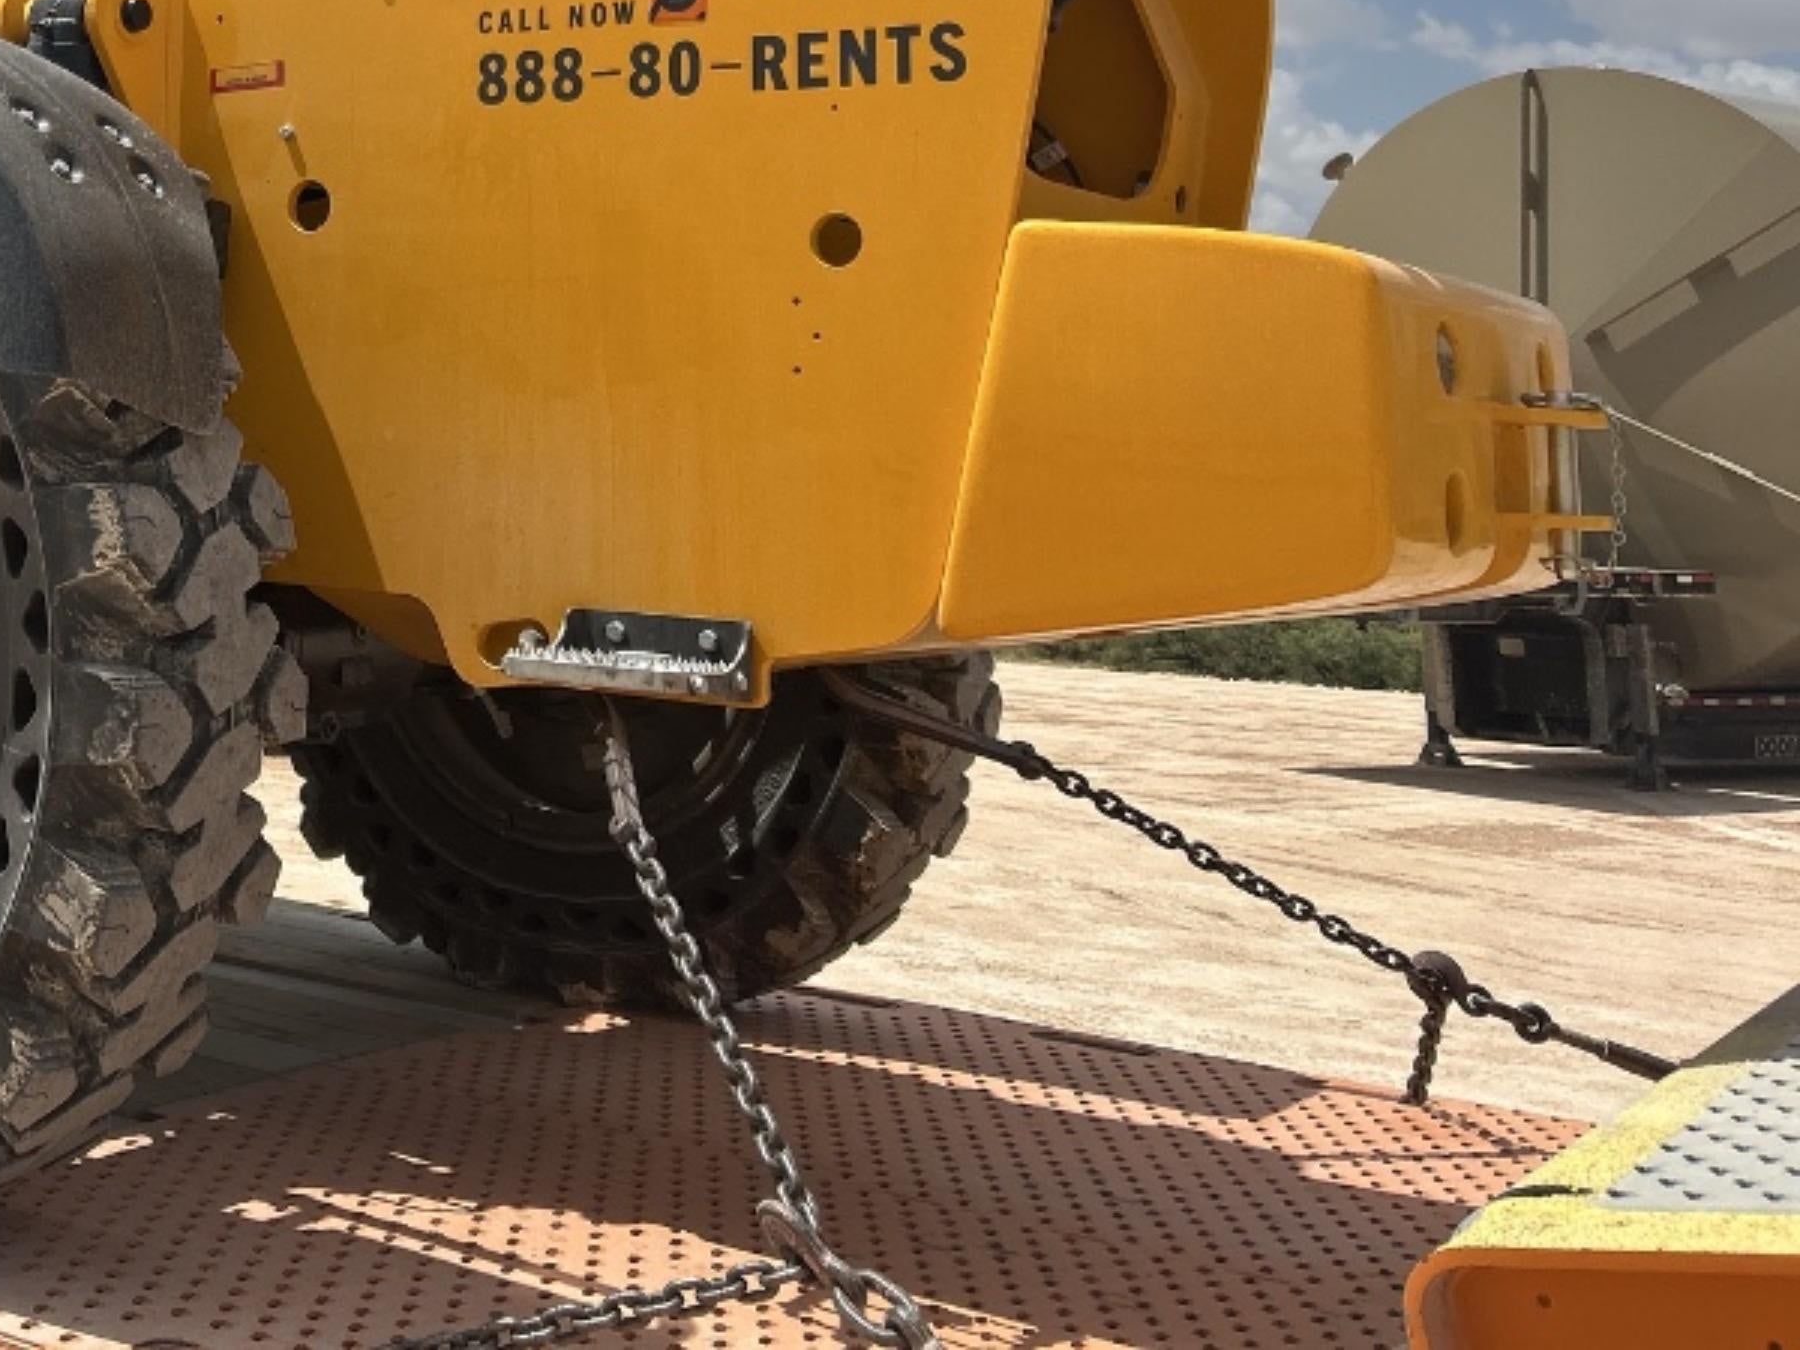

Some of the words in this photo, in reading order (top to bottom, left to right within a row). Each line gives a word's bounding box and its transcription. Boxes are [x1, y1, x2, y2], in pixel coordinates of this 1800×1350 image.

[478, 6, 550, 34] CALL
[568, 0, 635, 29] NOW
[477, 22, 968, 105] 888-80-RENTS
